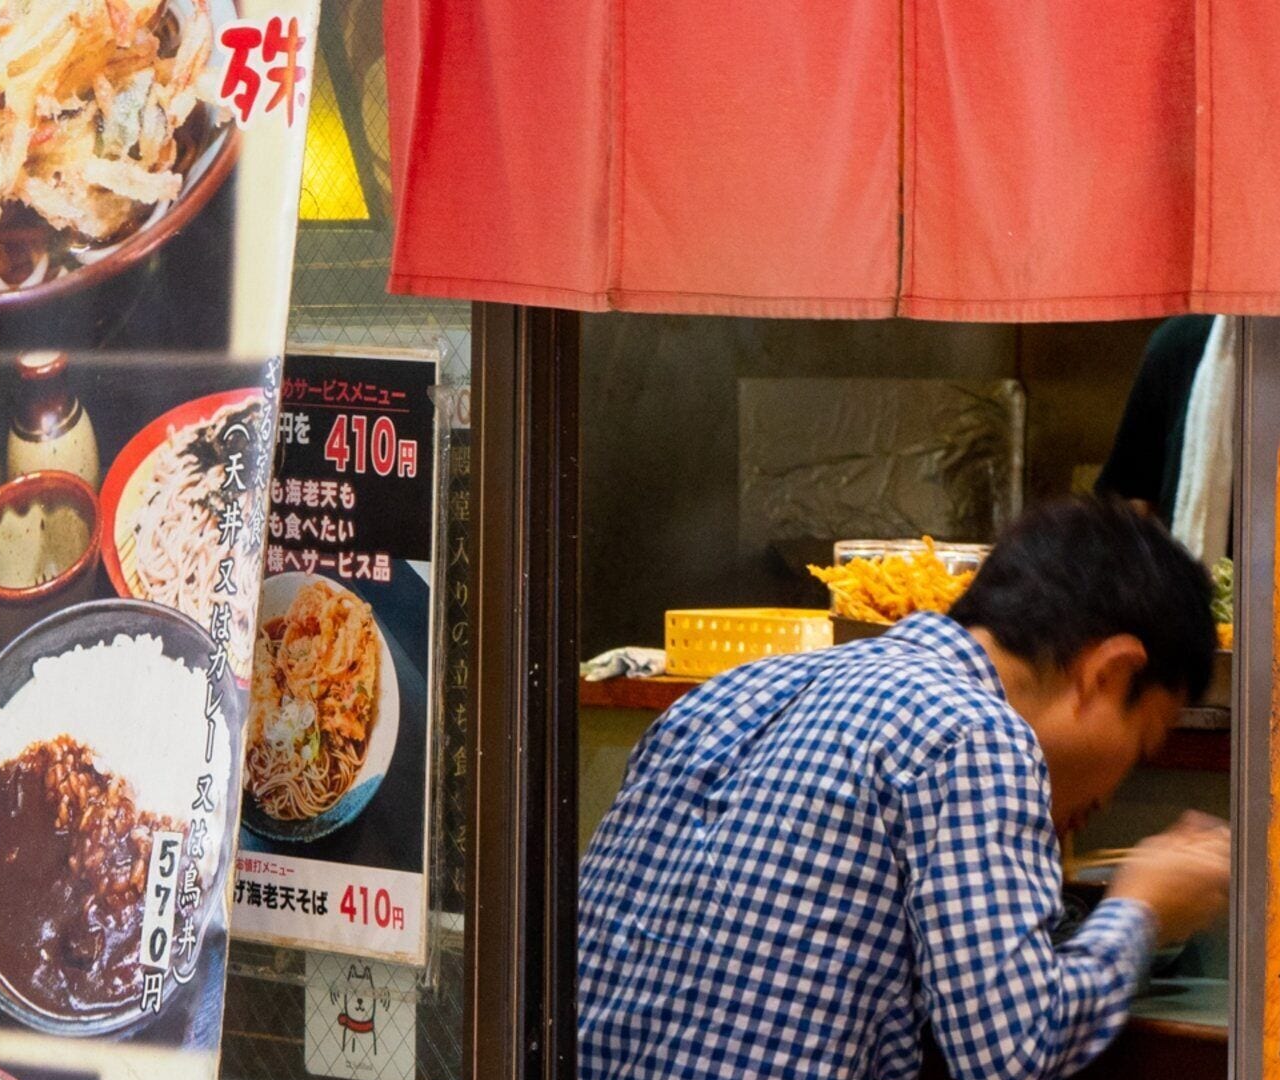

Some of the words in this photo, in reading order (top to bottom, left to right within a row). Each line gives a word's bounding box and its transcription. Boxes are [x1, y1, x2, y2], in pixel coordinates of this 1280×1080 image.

[219, 16, 306, 127] 殊
[325, 413, 417, 478] 410円
[340, 884, 405, 930] 410円
